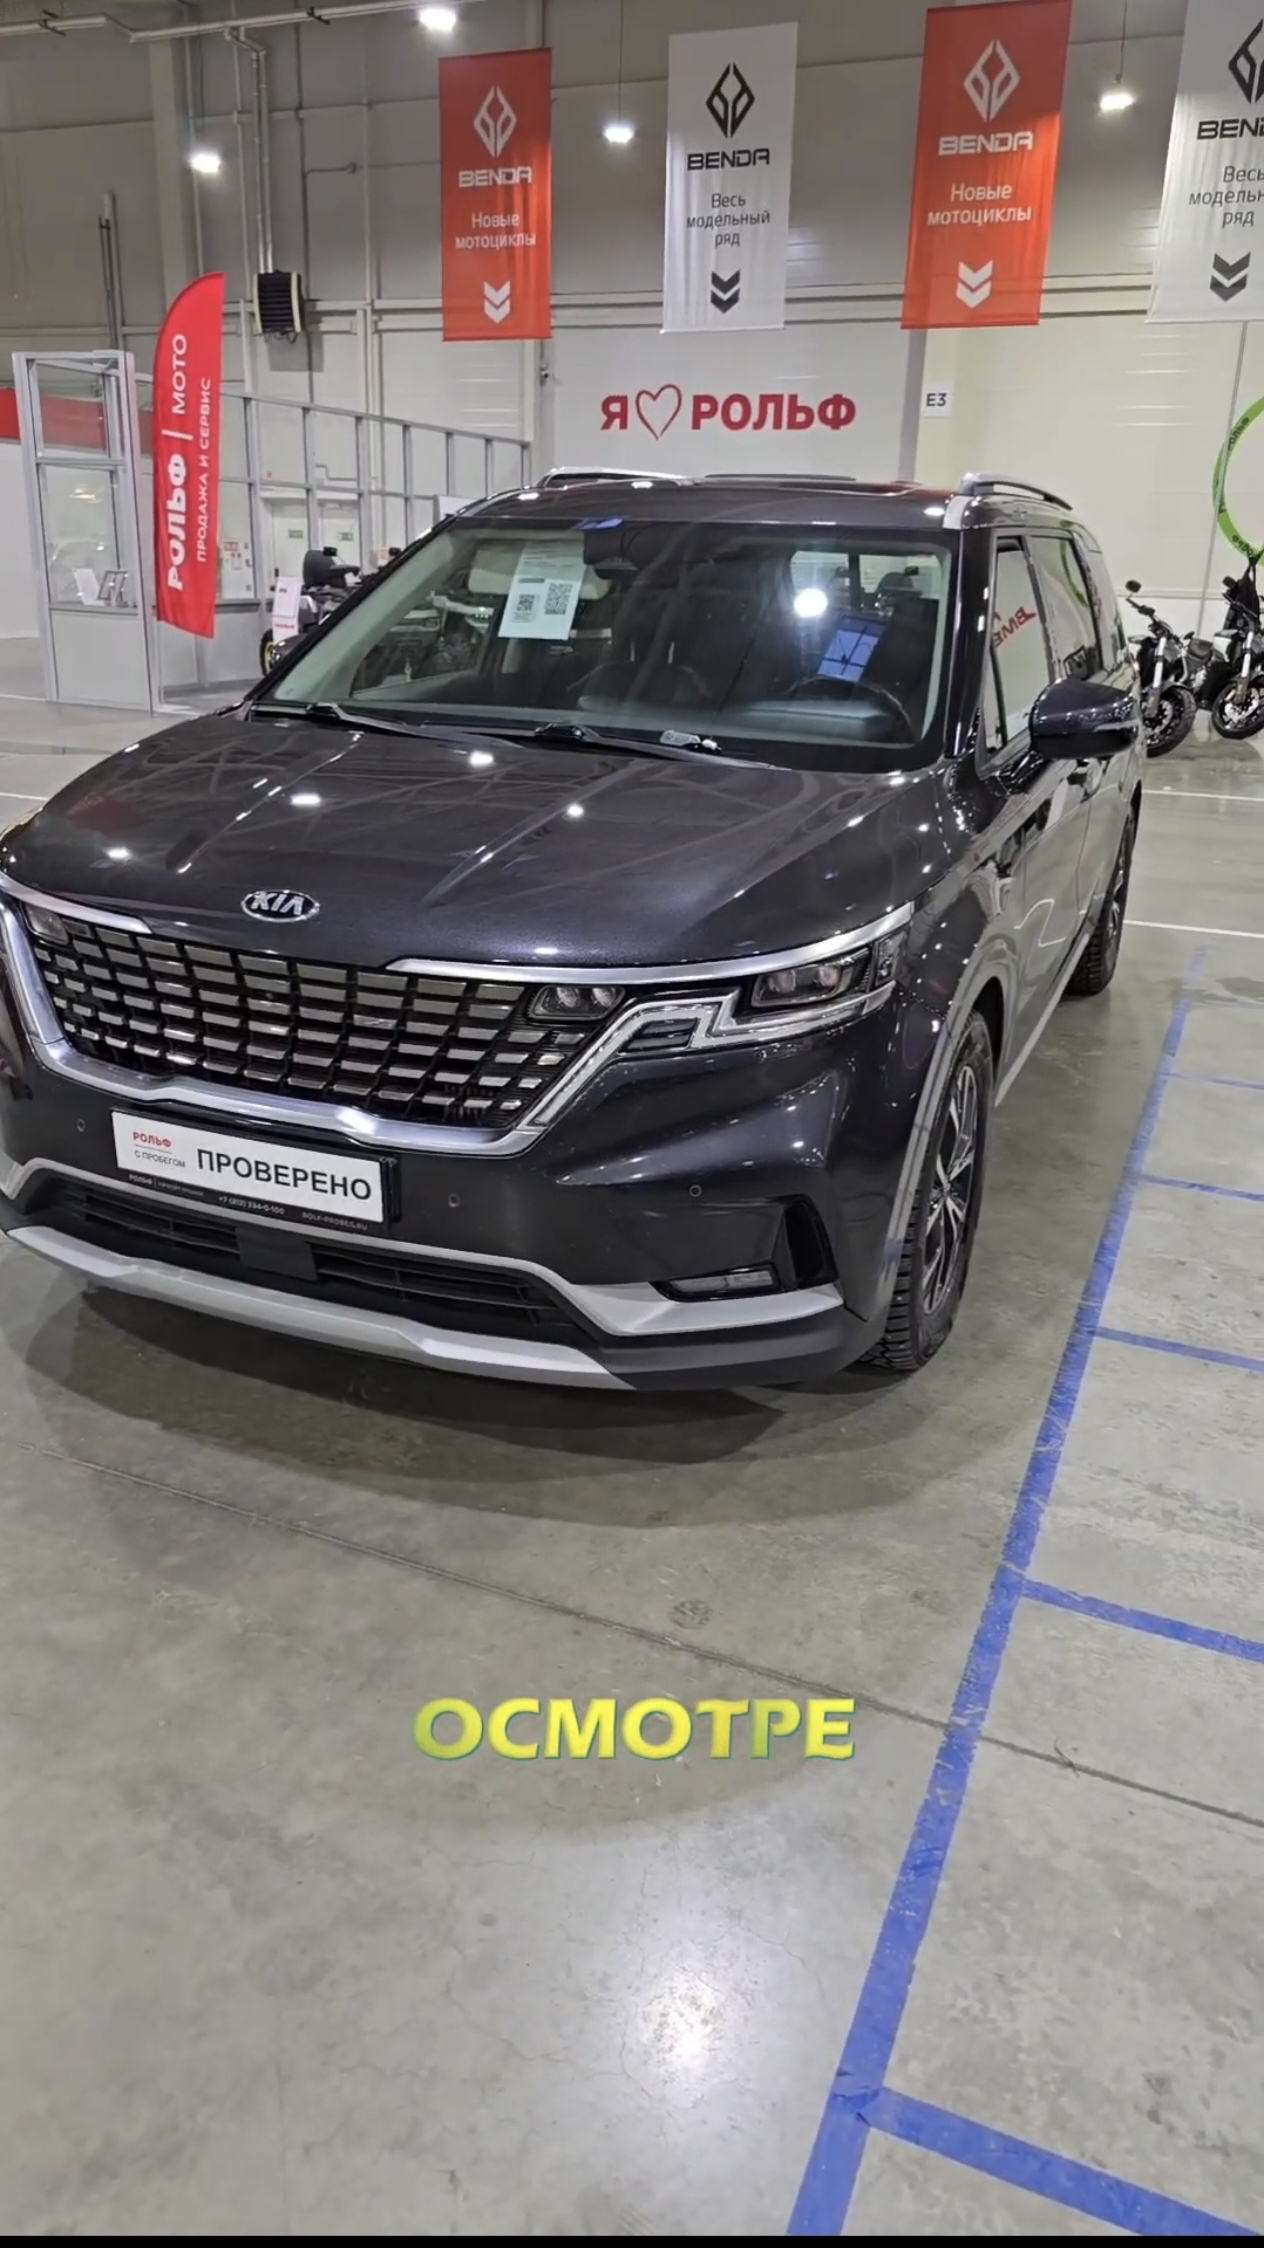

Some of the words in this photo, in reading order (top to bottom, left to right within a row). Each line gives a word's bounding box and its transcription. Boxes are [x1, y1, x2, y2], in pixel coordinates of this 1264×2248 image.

[938, 131, 1034, 156] BENDA
[687, 148, 770, 171] BENDA
[458, 166, 532, 188] BENDA
[711, 193, 746, 208] Весь
[950, 184, 1013, 202] Новые
[471, 211, 520, 229] Новые
[686, 210, 770, 230] модельный
[927, 206, 1032, 227] мотоциклы
[1222, 211, 1255, 229] ряд
[455, 233, 537, 251] мотоциклы
[714, 233, 741, 249] ряд
[172, 334, 187, 414] МОТО
[199, 378, 211, 450] СЕРВИС
[600, 394, 628, 431] Я
[691, 393, 856, 431] РОЛЬФ
[199, 455, 209, 467] И
[166, 453, 187, 590] РОЛЬФ
[197, 473, 208, 562] ПРОДАЖА
[251, 891, 305, 915] KIA
[132, 1131, 172, 1148] РОЛЬФ
[142, 1152, 186, 1168] ПРОБЕГОМ
[197, 1148, 372, 1201] ПРОВЕРЕНО
